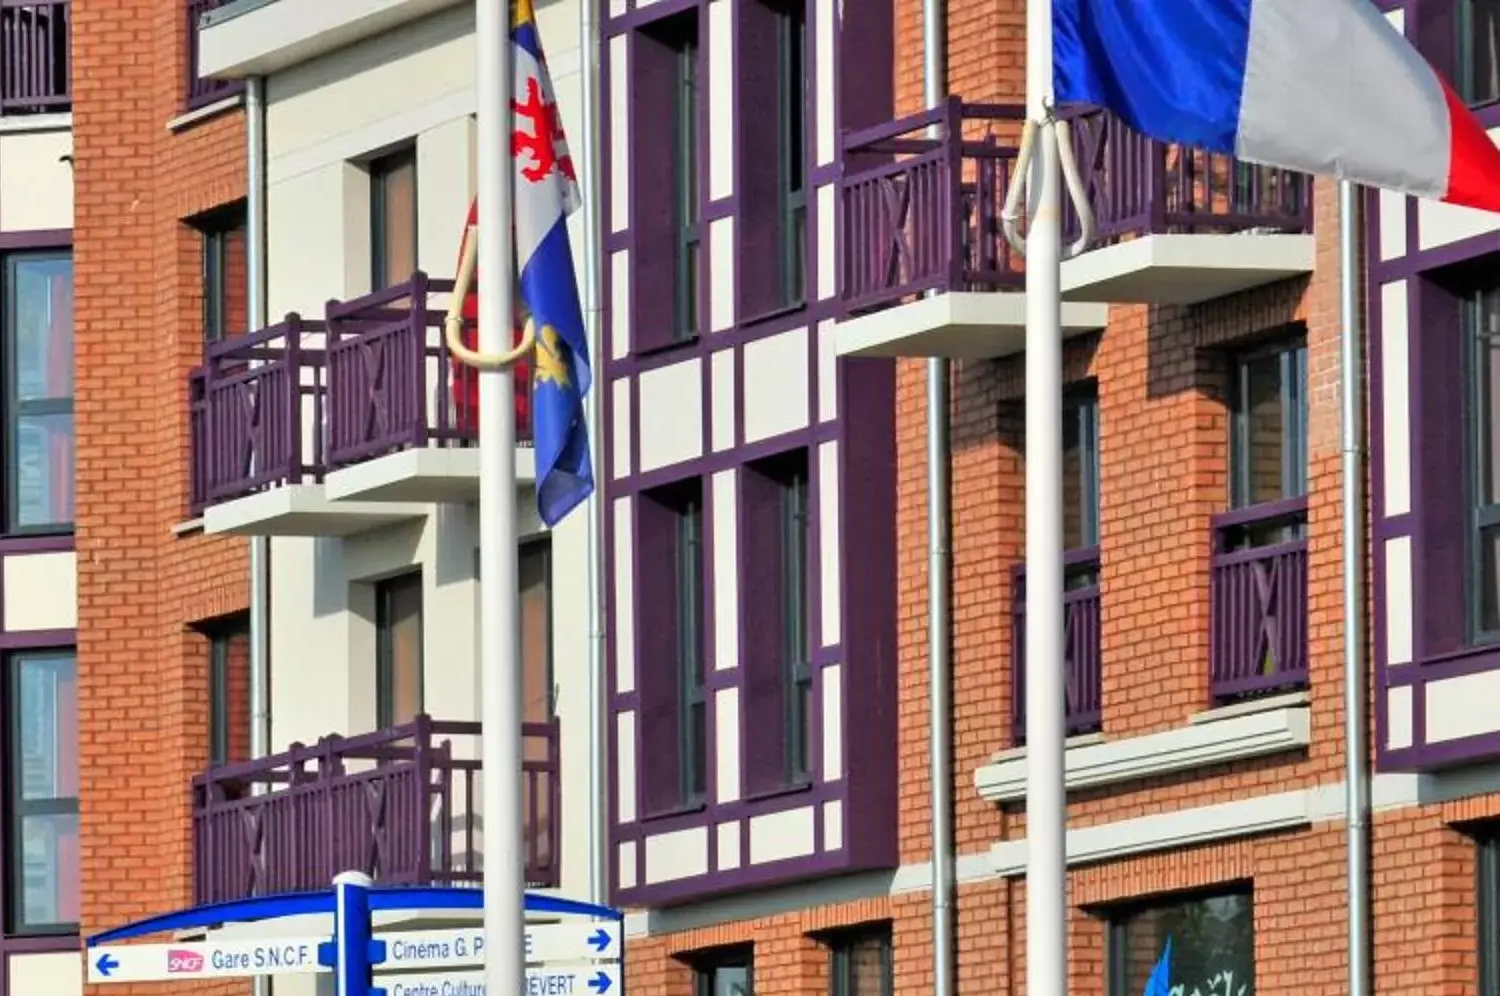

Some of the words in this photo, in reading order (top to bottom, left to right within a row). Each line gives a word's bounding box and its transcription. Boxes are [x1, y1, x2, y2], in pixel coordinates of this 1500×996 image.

[212, 949, 250, 970] Gare
[254, 945, 313, 968] S.N.C.F.
[392, 940, 449, 961] Cinéma
